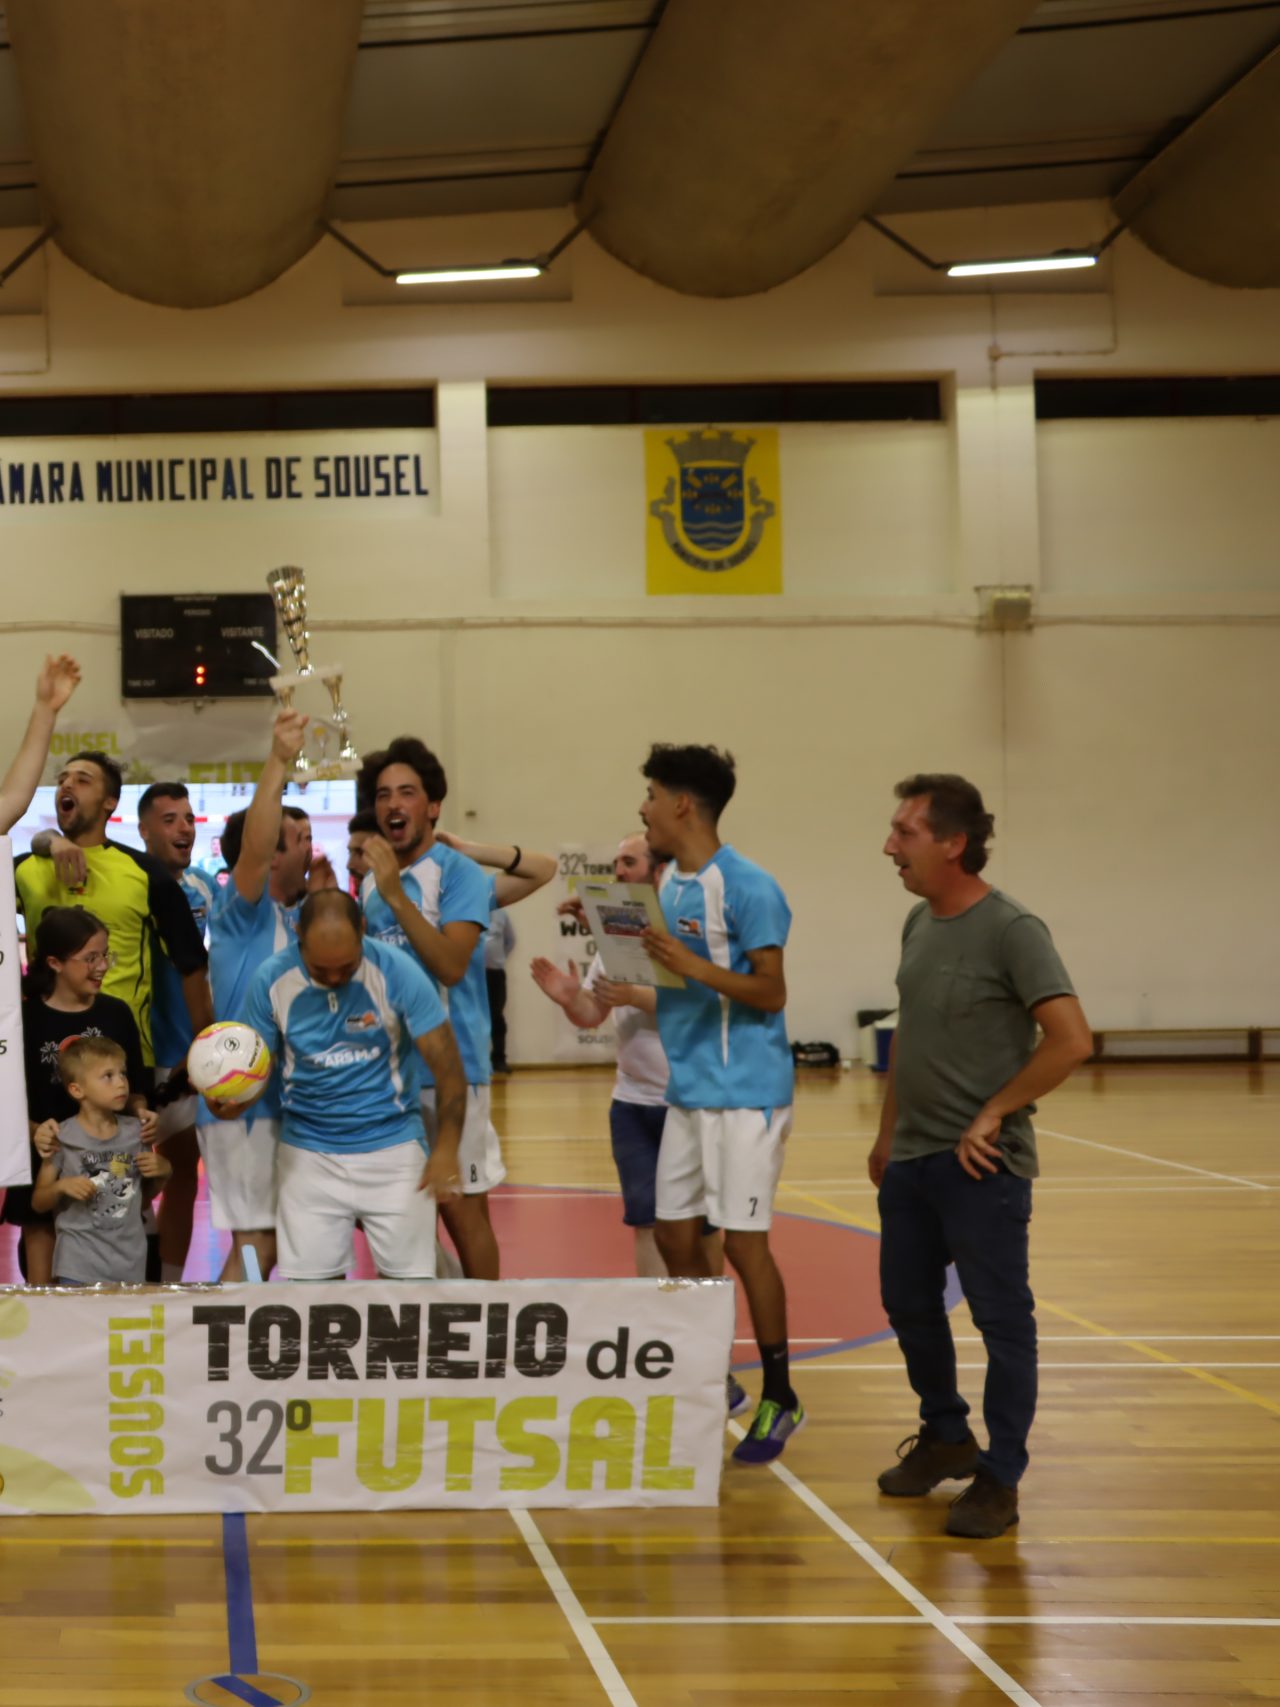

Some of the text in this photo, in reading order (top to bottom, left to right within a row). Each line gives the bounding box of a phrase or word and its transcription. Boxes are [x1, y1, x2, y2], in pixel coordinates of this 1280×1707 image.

[96, 457, 254, 505] MUNICIPAL
[266, 457, 302, 500] DE
[313, 454, 429, 498] SOUSEL
[221, 626, 264, 638] VISITANTE
[50, 731, 120, 756] OUSEL
[470, 1163, 478, 1183] 8
[749, 1196, 758, 1217] 7
[192, 1302, 676, 1382] TORNEIO de
[108, 1304, 165, 1498] SOUSEL
[282, 1394, 696, 1495] FUTSAL
